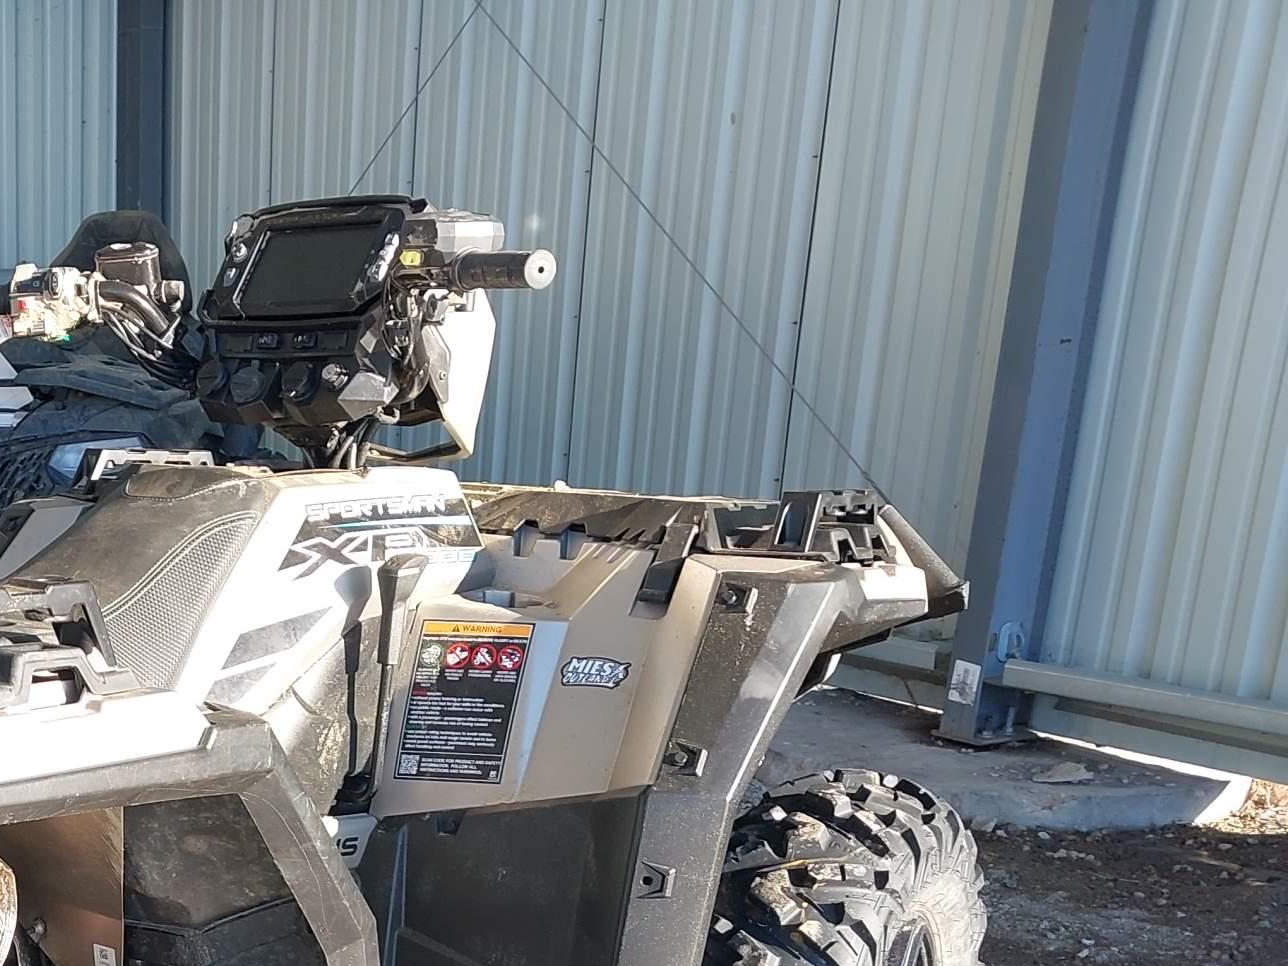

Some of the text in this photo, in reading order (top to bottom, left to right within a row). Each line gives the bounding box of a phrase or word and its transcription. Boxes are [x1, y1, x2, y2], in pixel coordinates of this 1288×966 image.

[306, 494, 446, 522] SPORTSMAN
[463, 625, 502, 633] WARNING
[568, 658, 615, 676] MIES
